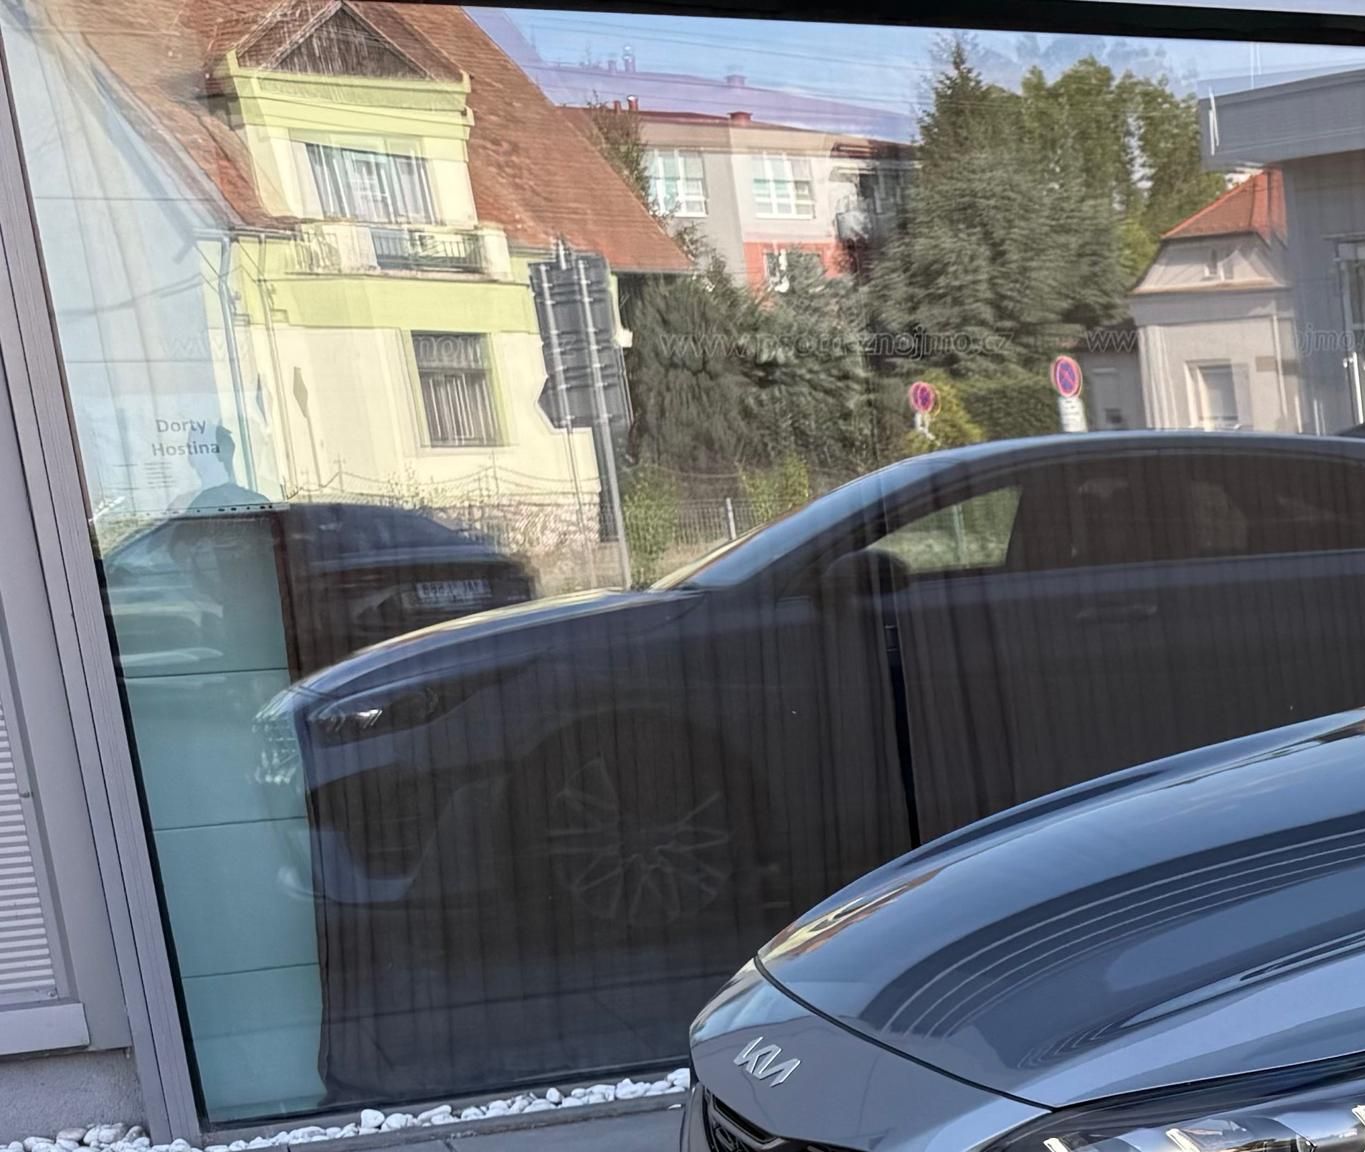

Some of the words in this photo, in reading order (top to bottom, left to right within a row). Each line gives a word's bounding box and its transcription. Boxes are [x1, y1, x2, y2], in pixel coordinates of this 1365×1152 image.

[156, 418, 207, 435] Dorty
[151, 441, 221, 457] Hostina
[733, 1035, 802, 1088] KIA
